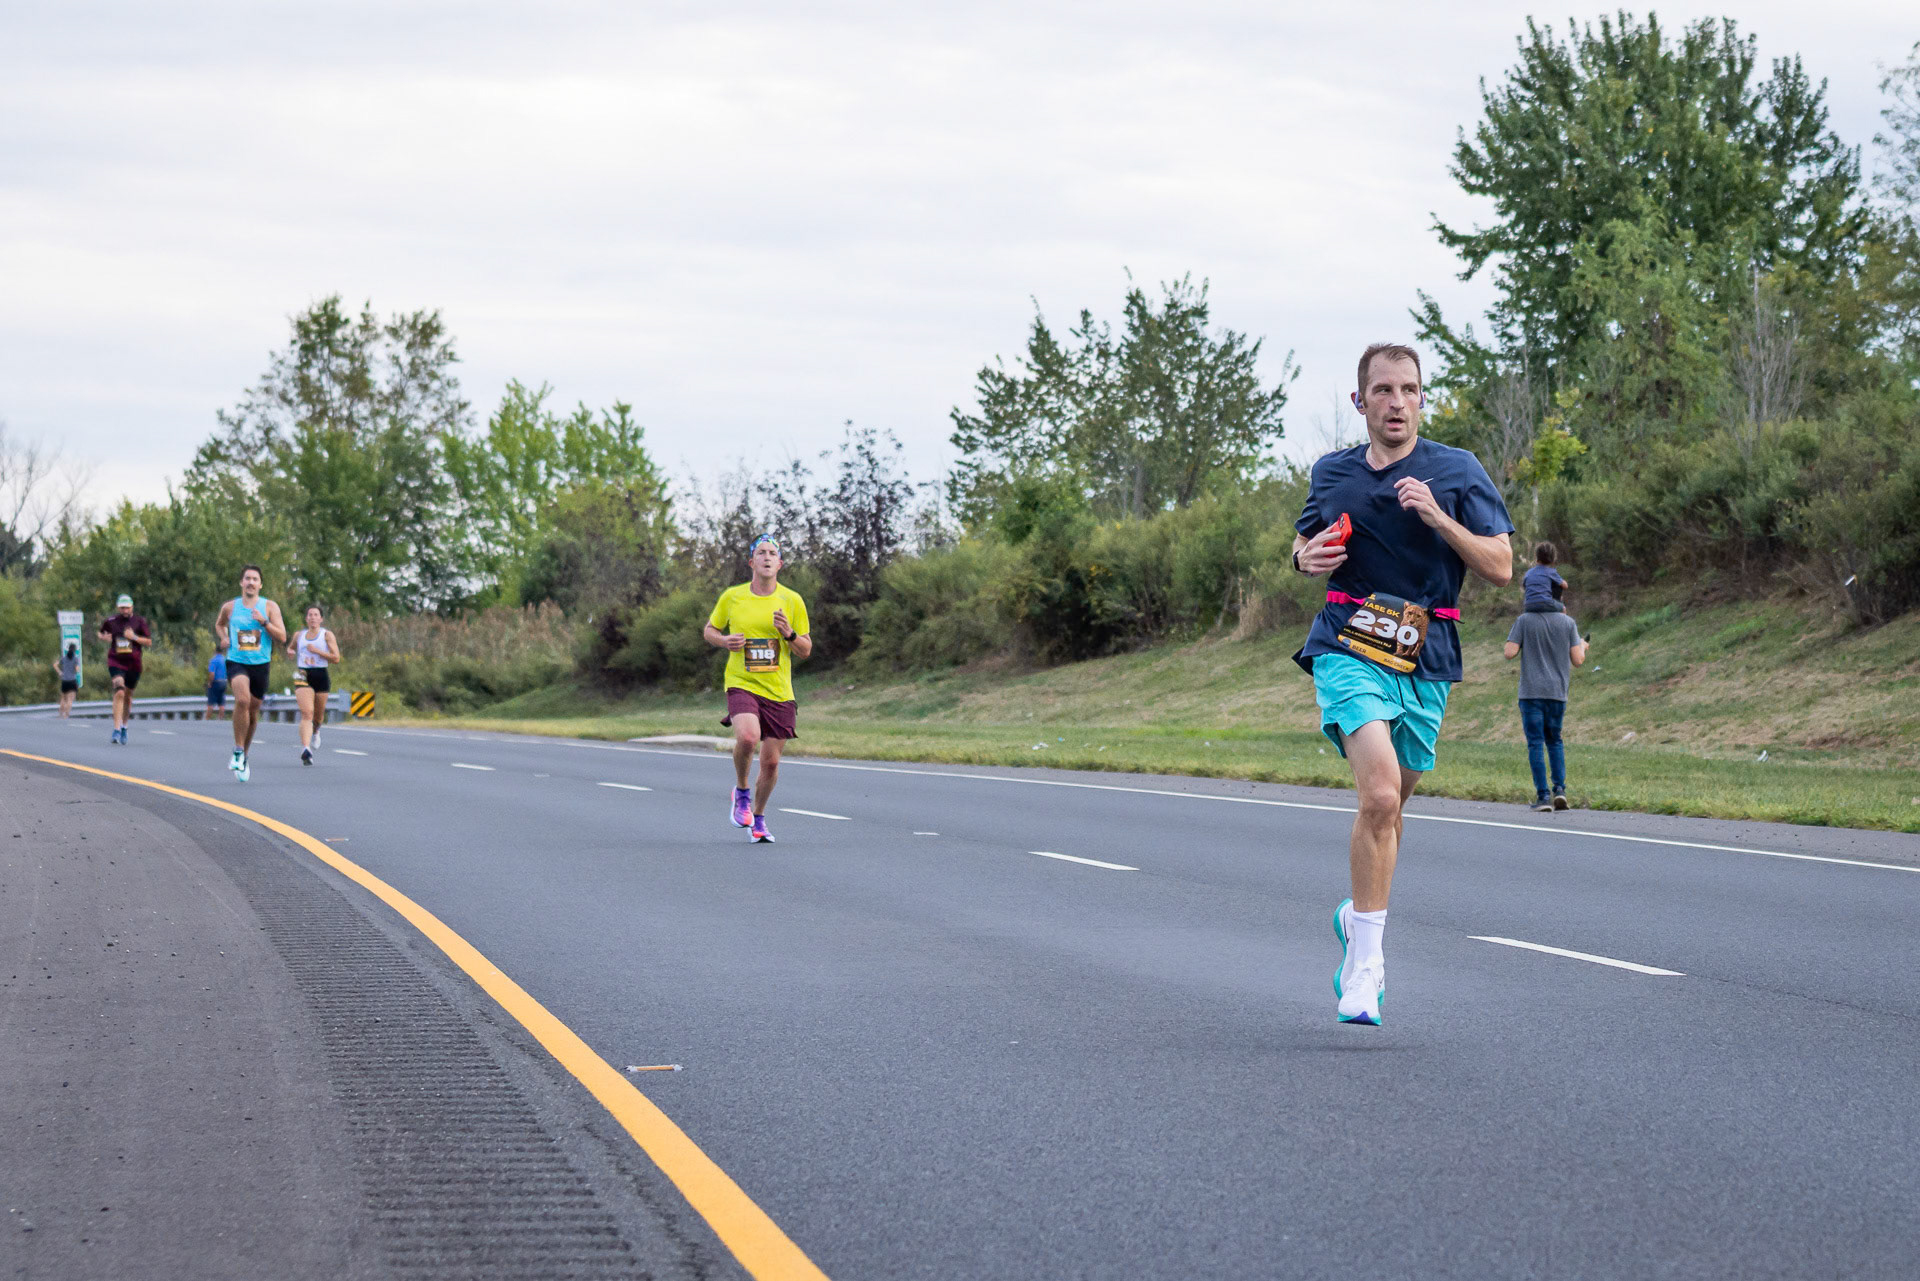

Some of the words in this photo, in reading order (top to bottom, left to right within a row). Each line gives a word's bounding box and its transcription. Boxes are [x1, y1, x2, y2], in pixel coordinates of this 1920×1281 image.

[1386, 608, 1401, 618] 5K
[1351, 609, 1419, 646] 230
[750, 649, 775, 660] 118
[1351, 645, 1367, 654] BEER
[1383, 657, 1394, 666] BAG
[1394, 660, 1410, 672] CHECK
